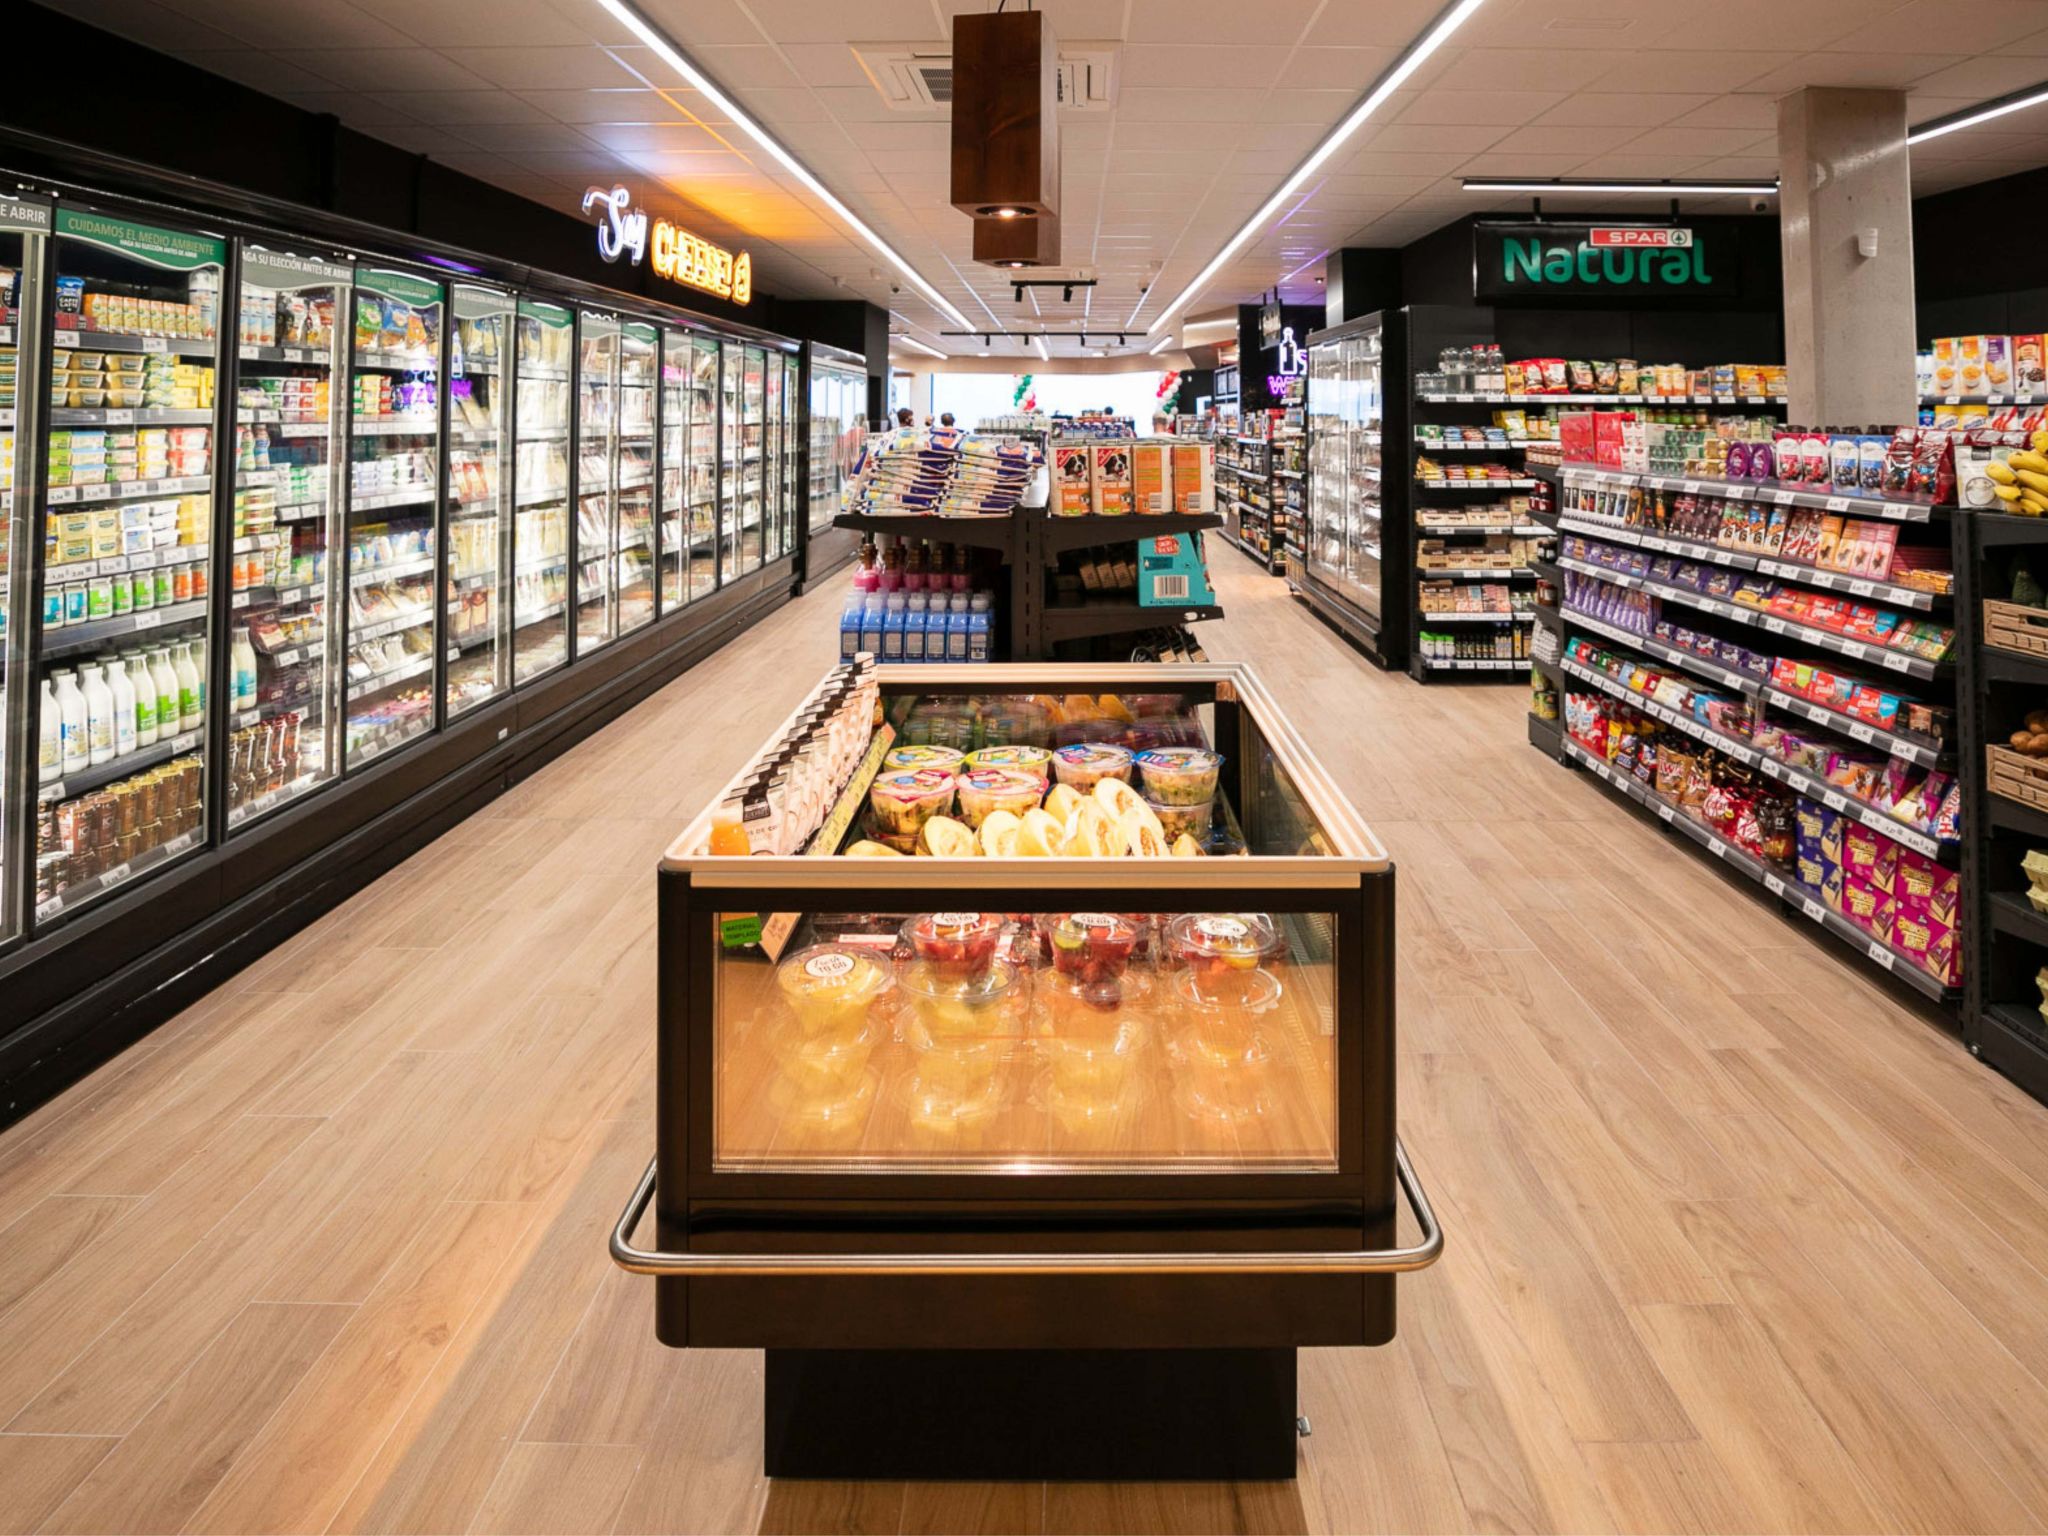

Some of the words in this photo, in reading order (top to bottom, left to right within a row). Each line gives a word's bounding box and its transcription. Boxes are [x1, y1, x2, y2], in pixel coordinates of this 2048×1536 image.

[9, 206, 46, 223] ABRIR
[67, 216, 125, 239] CUIDAMOS
[126, 229, 137, 241] EL
[138, 231, 171, 248] MEDIO
[171, 238, 215, 256] AMBIENTE
[1609, 231, 1667, 243] SPAR
[242, 250, 258, 263] AGA
[258, 254, 268, 265] SU
[269, 255, 301, 271] ELECCIÓN
[301, 263, 323, 275] ANTES
[323, 267, 332, 277] DE
[1502, 237, 1713, 284] Natural
